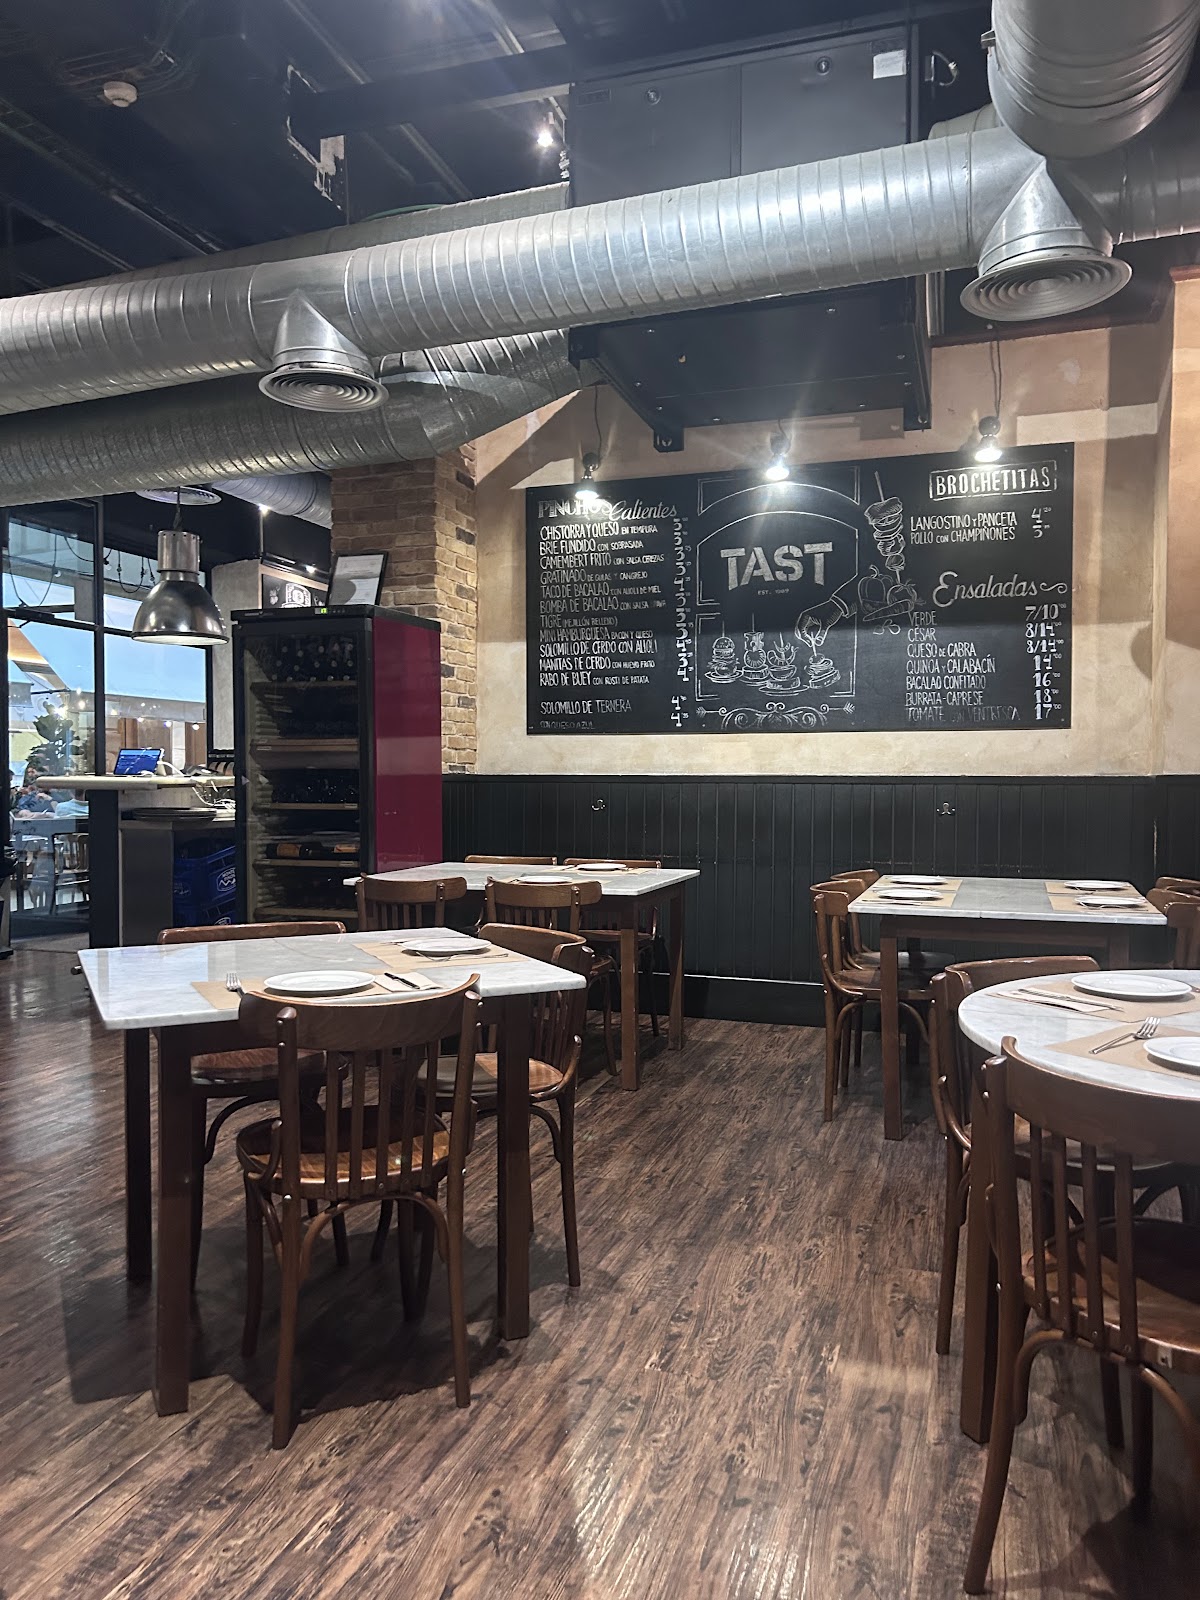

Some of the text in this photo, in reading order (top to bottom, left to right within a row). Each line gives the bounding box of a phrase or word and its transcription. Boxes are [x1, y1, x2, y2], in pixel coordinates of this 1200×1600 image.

[936, 466, 1050, 496] BROCHETITAS
[609, 499, 677, 521] Calientes
[910, 514, 970, 531] LANGOSTINO
[977, 512, 1018, 527] PANCETA
[540, 523, 586, 540] CHISTORRA
[592, 521, 619, 538] QUESO
[621, 527, 629, 535] EN
[910, 531, 933, 545] POLLO
[951, 526, 1016, 543] CHAMPIÑONES
[540, 540, 559, 556] BRIE
[560, 538, 596, 554] FUNDIDO
[597, 543, 609, 552] CON
[540, 553, 588, 569] CAMEMBERT
[590, 552, 612, 566] FRITO
[720, 541, 833, 591] TAST
[540, 569, 586, 584] GRATINADO
[540, 585, 561, 599] TACO
[561, 584, 572, 598] DE
[574, 582, 610, 597] BACALAO
[932, 571, 1037, 607] Ensaladas
[540, 599, 568, 614] BOMBA
[570, 598, 580, 612] DE
[582, 596, 619, 612] BACALAO
[540, 614, 561, 628] TIGRE
[908, 611, 937, 627] VERDE
[908, 626, 936, 642] CÉSAR
[540, 642, 580, 658] SOLOMILLO
[580, 641, 590, 655] DE
[592, 640, 617, 655] CERDO
[618, 640, 633, 653] CON
[907, 643, 937, 658] QUESO
[947, 642, 976, 658] CABRA
[539, 657, 573, 671] MANITAS
[574, 656, 584, 670] DE
[586, 656, 611, 670] CERDO
[611, 661, 622, 669] CON
[906, 659, 940, 675] QUINOA
[947, 654, 996, 674] CALABACÍN
[540, 672, 559, 687] RABO
[561, 672, 570, 686] DE
[572, 671, 591, 686] BUEY
[622, 676, 629, 685] DE
[906, 675, 941, 690] BACALAO
[943, 674, 986, 690] CONFITADO
[540, 701, 580, 715] SOLOMILLO
[582, 700, 593, 714] DE
[595, 699, 632, 713] TERNERA
[905, 706, 945, 722] TOMATE
